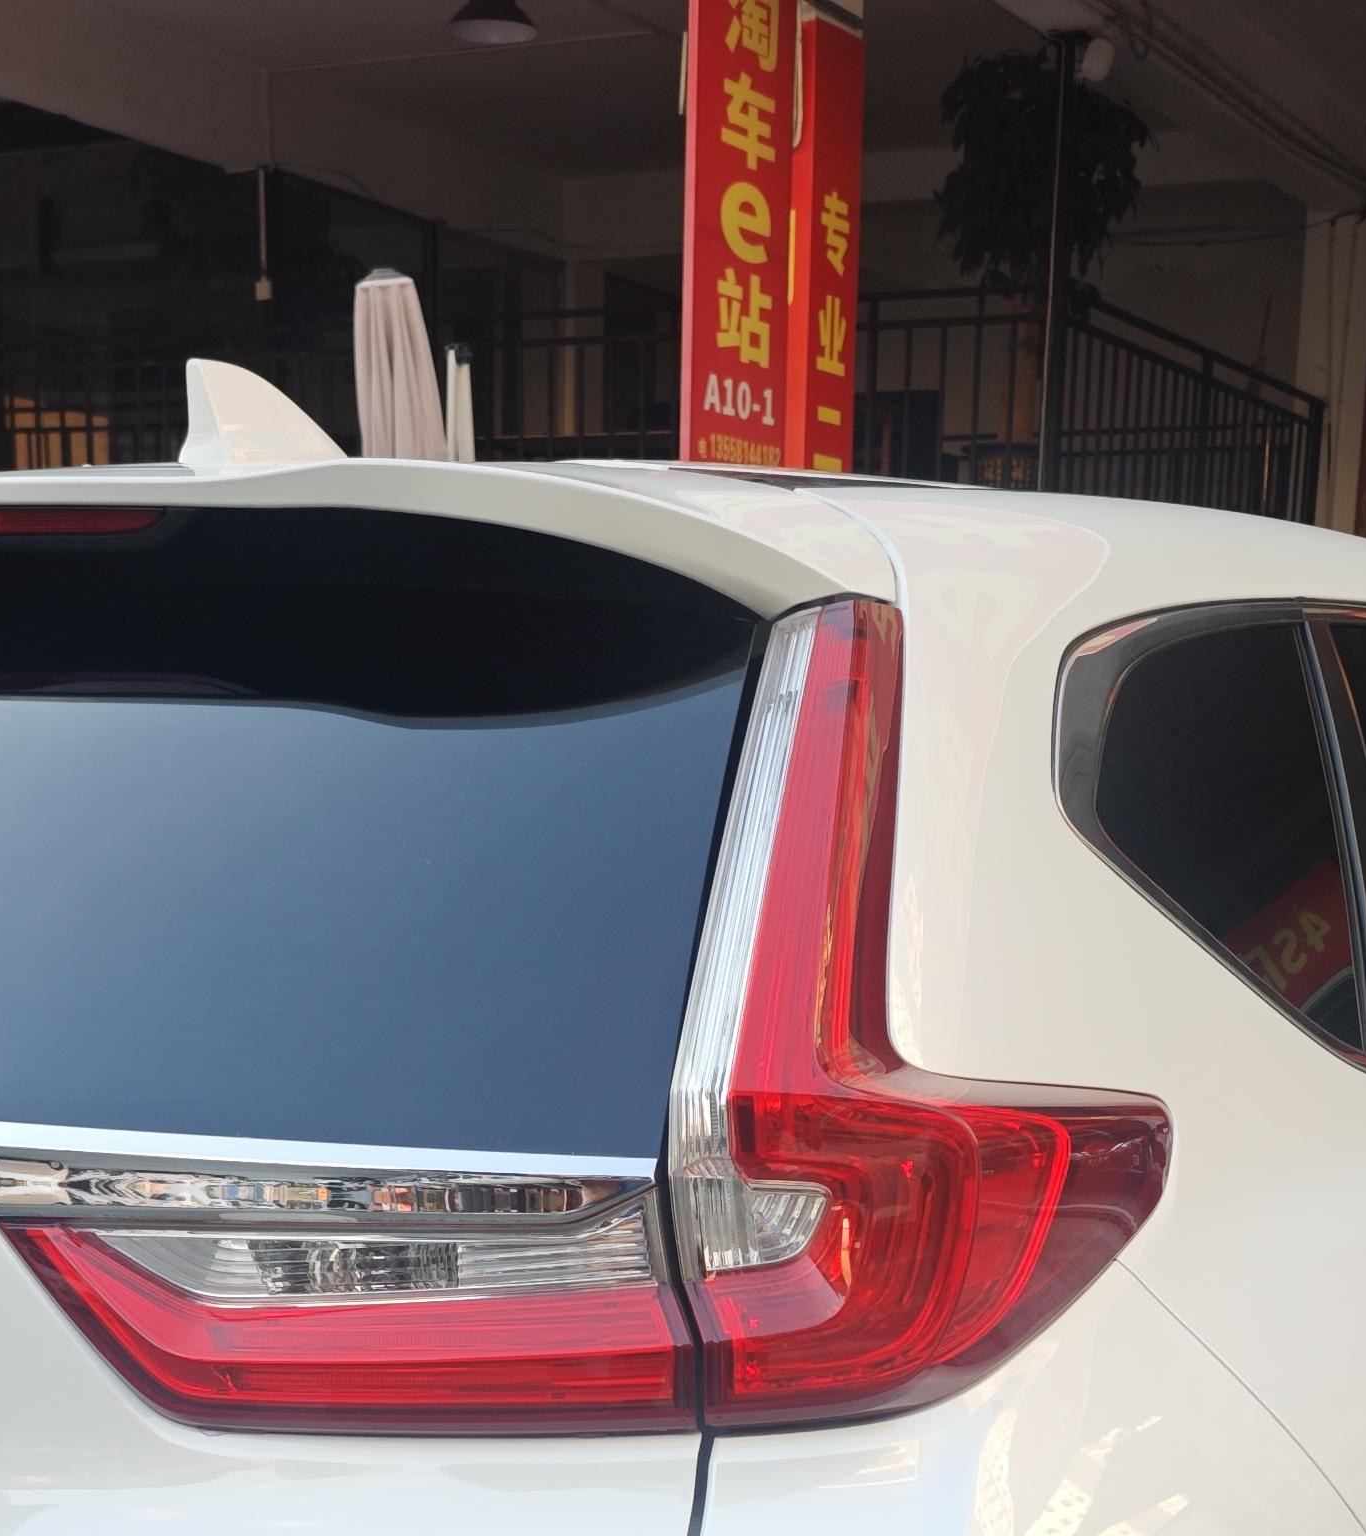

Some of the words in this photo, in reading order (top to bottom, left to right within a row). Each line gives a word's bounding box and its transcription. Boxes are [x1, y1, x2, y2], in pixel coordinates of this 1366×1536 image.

[716, 0, 779, 369] 淘车e站
[703, 373, 775, 427] A10-1
